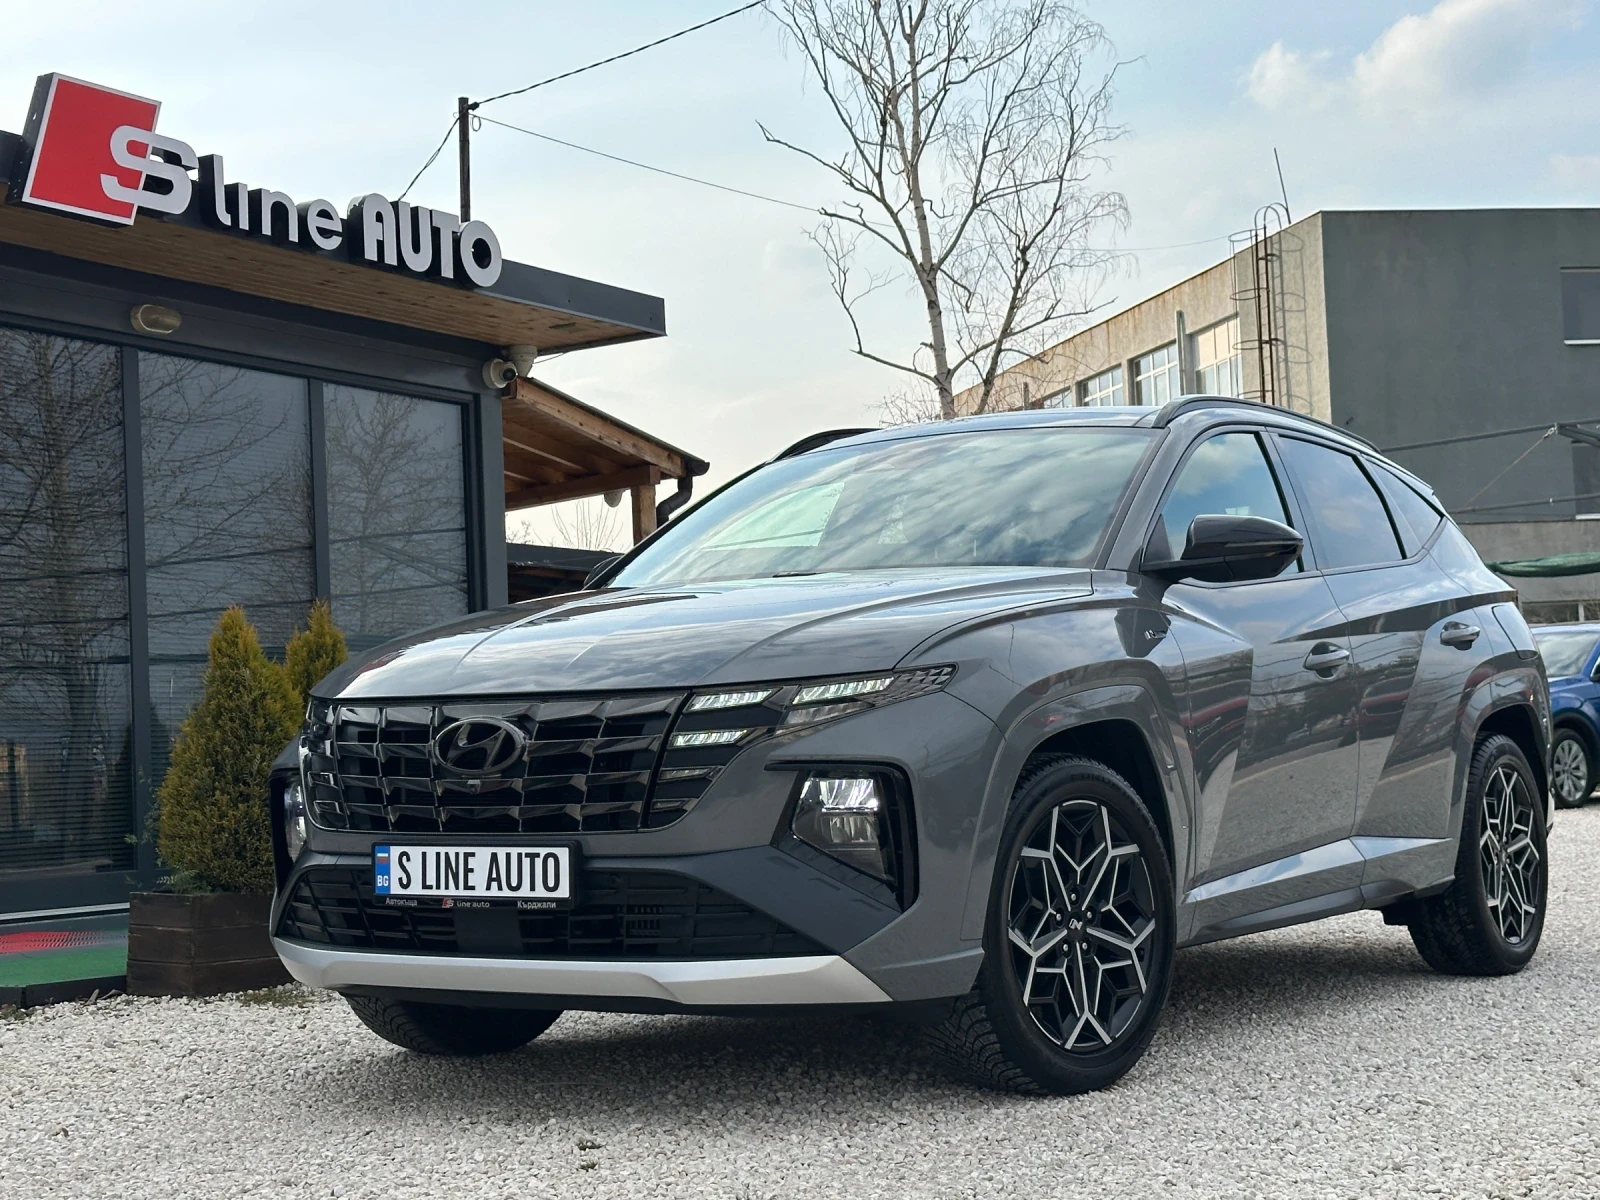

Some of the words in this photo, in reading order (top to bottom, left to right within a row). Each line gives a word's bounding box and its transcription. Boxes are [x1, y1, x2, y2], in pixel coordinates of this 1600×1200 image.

[100, 125, 199, 215] S
[362, 193, 502, 288] AUTO
[398, 851, 412, 890] S
[421, 851, 476, 891] LINE
[485, 851, 561, 893] AUTO
[377, 875, 389, 887] BG
[385, 897, 418, 907] Автокъща
[456, 900, 471, 908] line
[472, 900, 490, 908] auto
[517, 900, 557, 910] Кърджали
